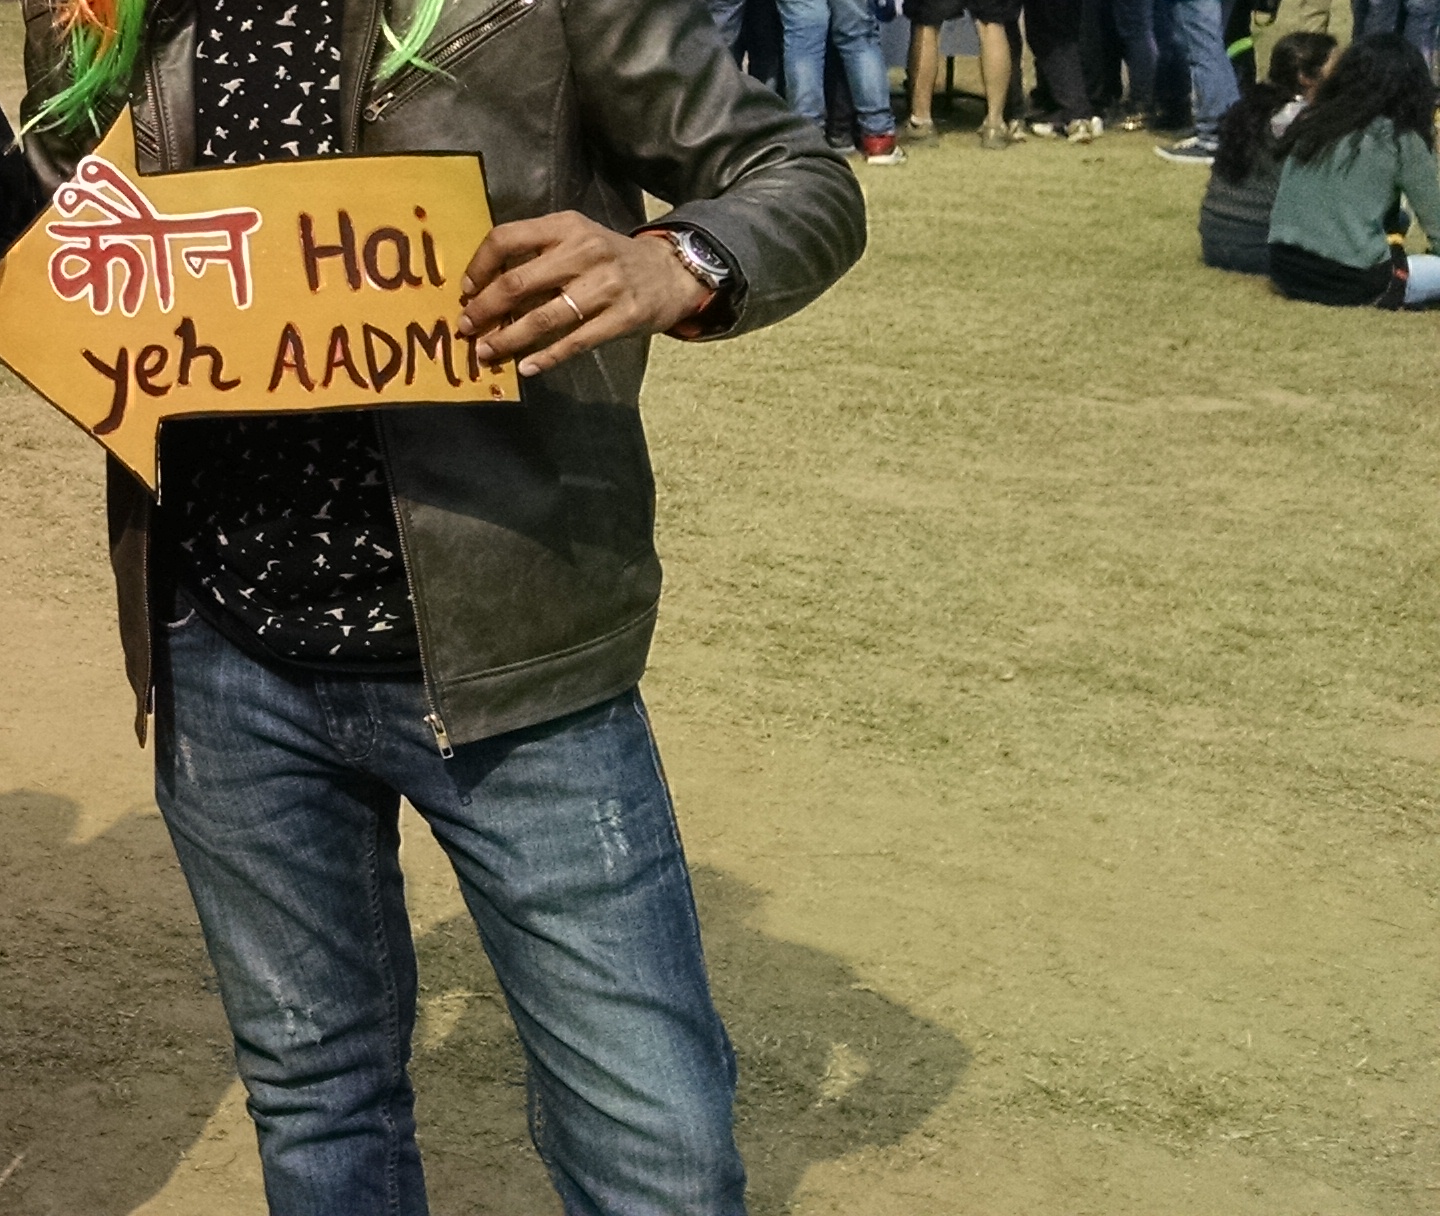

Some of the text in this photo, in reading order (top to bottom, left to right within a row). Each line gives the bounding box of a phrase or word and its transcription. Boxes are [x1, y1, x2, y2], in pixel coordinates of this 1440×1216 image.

[45, 154, 448, 317] कौन Hai
[80, 315, 241, 436] yeh
